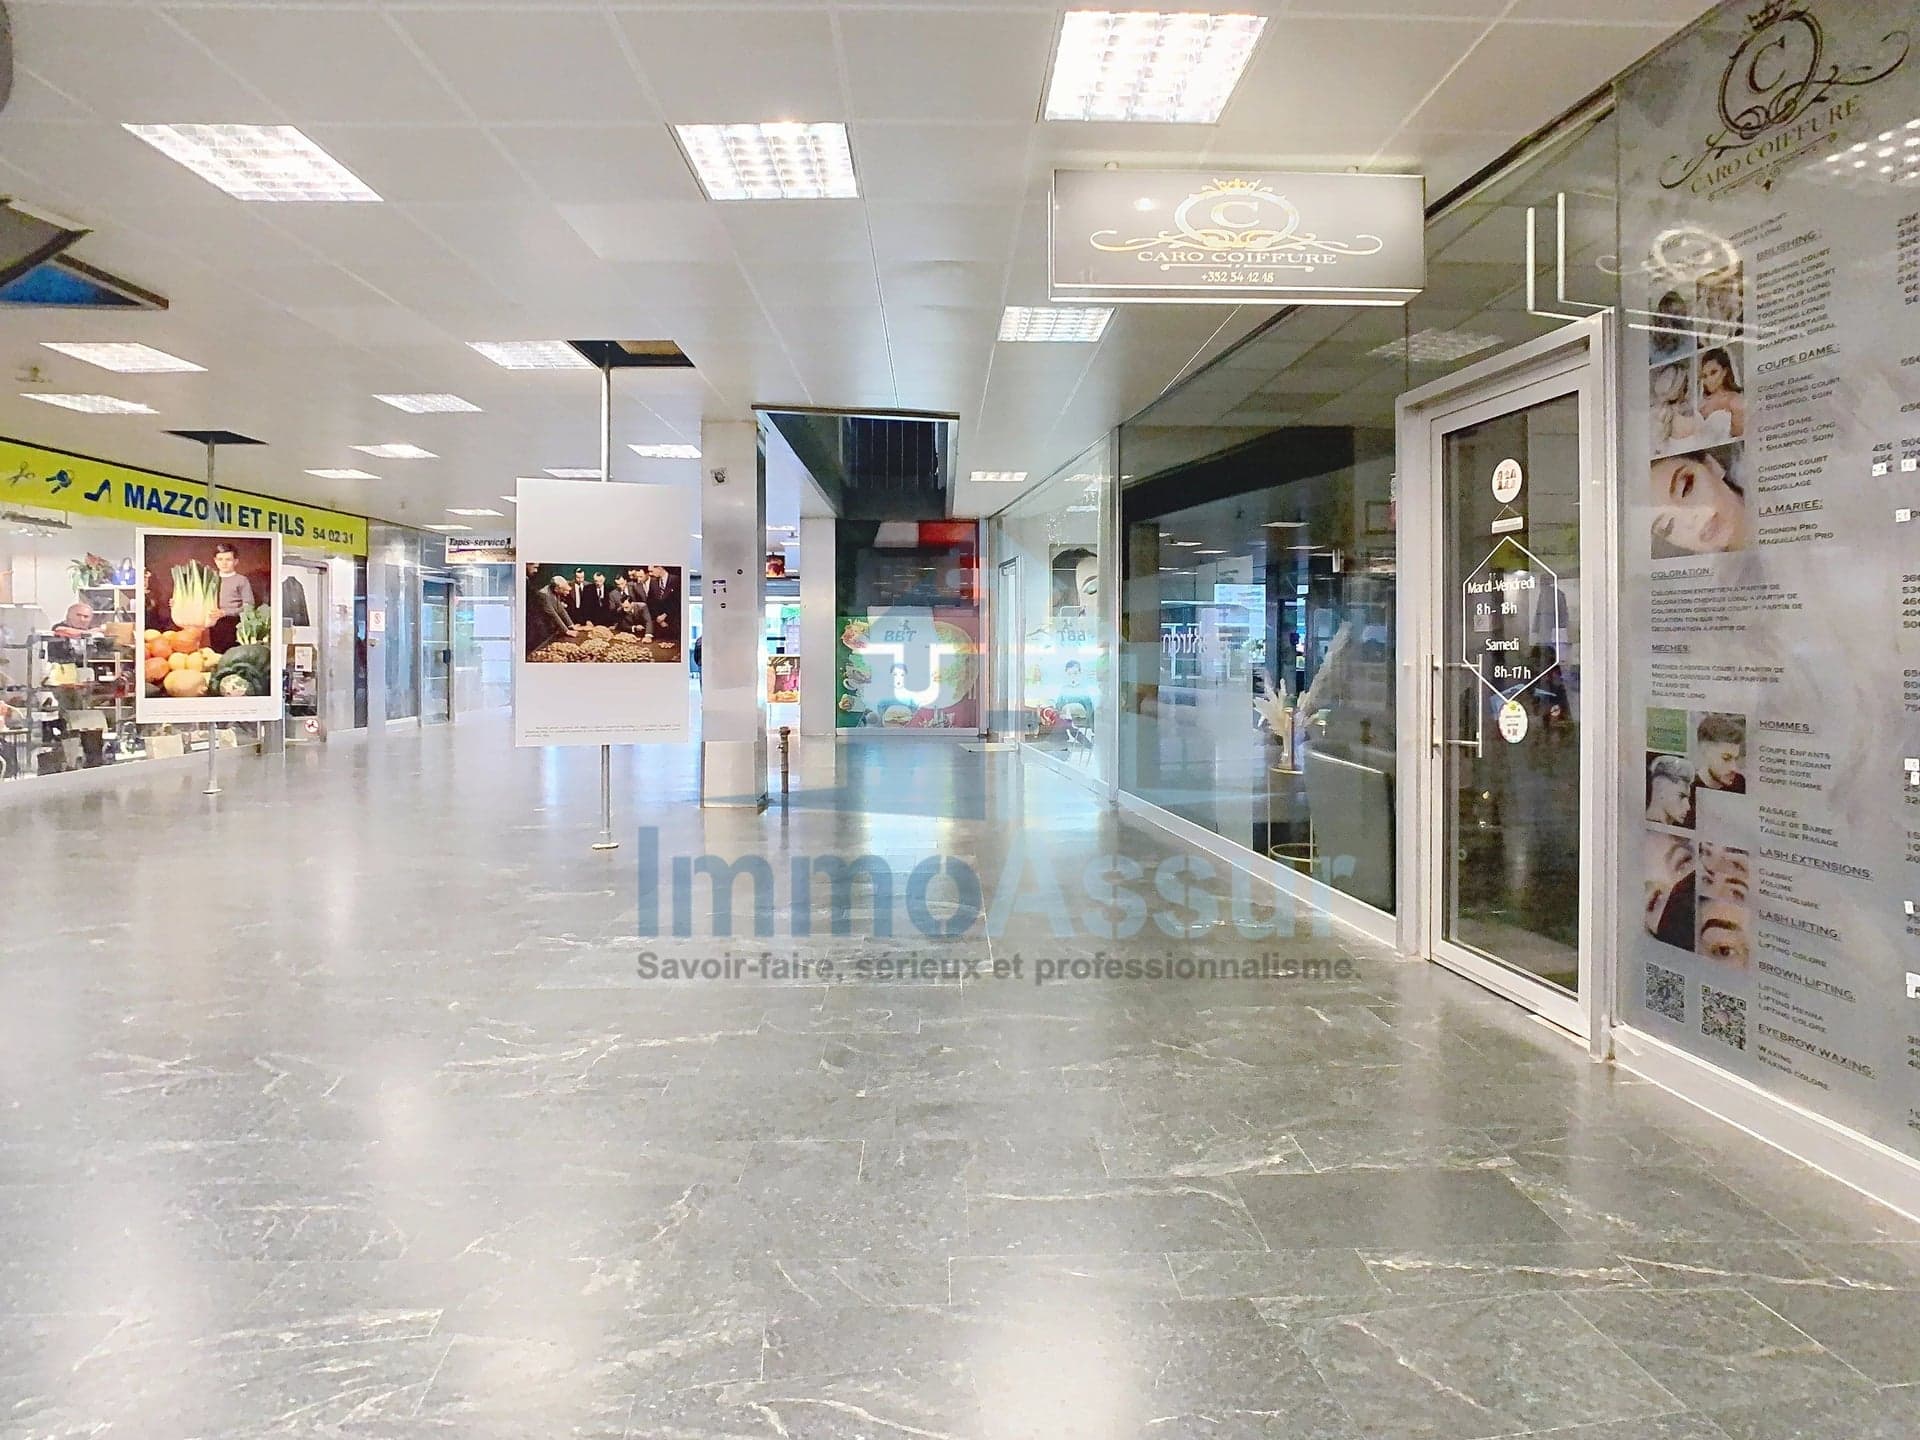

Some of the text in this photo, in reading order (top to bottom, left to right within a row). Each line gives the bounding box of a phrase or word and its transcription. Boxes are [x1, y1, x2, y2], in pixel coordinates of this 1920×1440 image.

[1690, 95, 1861, 194] CARO COIFFURE
[1210, 201, 1261, 229] C
[1137, 249, 1337, 265] CARO COIFFURE
[1757, 343, 1835, 373] COUPE DAME
[1787, 373, 1815, 385] DAME
[1788, 416, 1813, 427] DAME
[1765, 427, 1809, 441] BRUSHING
[1758, 454, 1829, 473] CHIGNON COURT
[1758, 466, 1823, 483] CHIGNON LONG
[1758, 479, 1813, 493] MAQUILLAGE
[124, 482, 354, 545] MAZZONI ET FILS 54 02 31
[1759, 506, 1772, 517] LA
[1758, 523, 1818, 536] CHIGNON PRO
[1758, 531, 1834, 545] MAQUILLAGE PRO
[1651, 567, 1711, 580] COLORATION
[1485, 638, 1520, 651] Samedi
[1759, 720, 1810, 732] HOMMES
[1759, 745, 1831, 760] COUPE ENFANTS
[1759, 755, 1787, 766] COUPE
[1759, 775, 1787, 786] COUPE
[1759, 846, 1789, 861] LASH
[1758, 909, 1789, 923] LASH
[1758, 961, 1802, 983] BROWN
[1758, 992, 1791, 1010] LIFTING
[1758, 1023, 1817, 1053] EYEBROW
[1758, 1044, 1793, 1065] WAXING
[1758, 1055, 1793, 1074] WAXING
